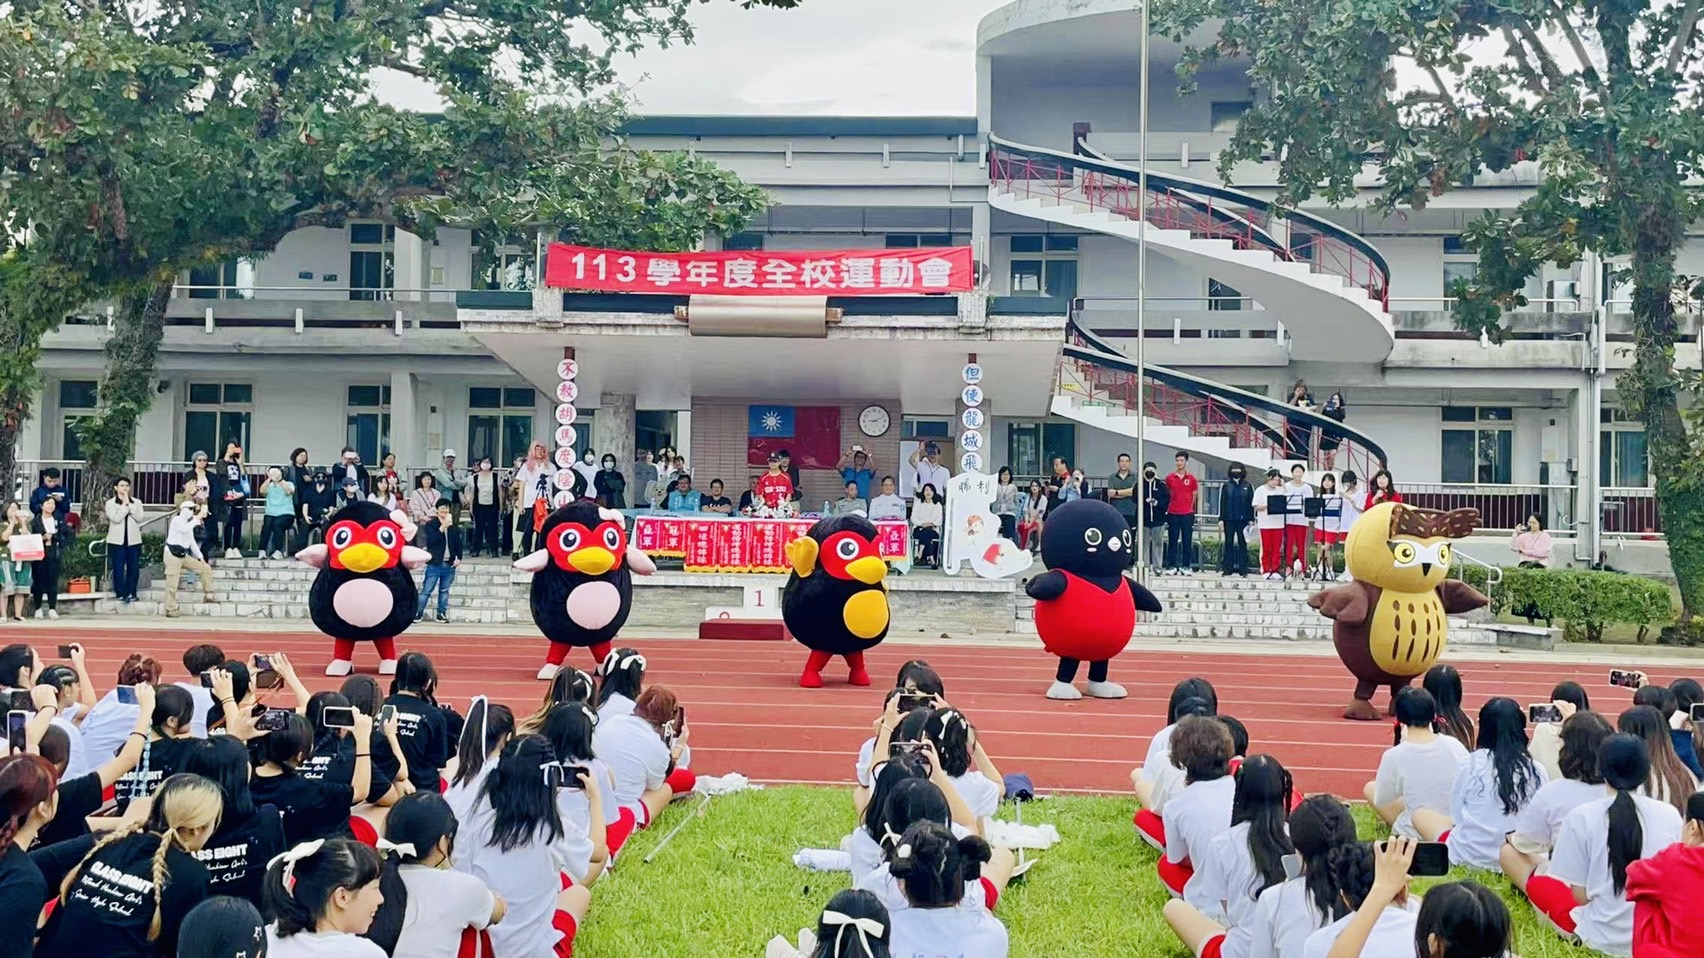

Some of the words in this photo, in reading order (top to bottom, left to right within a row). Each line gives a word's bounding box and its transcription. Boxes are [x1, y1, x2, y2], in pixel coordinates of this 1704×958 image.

[571, 252, 953, 290] 113學年度全校運動會
[963, 366, 981, 472] 但使龍城飛
[958, 477, 990, 495] 勝利
[755, 590, 764, 607] 1
[214, 843, 248, 859] EIGHT
[90, 861, 122, 883] CLASS
[117, 874, 154, 895] EIGHT
